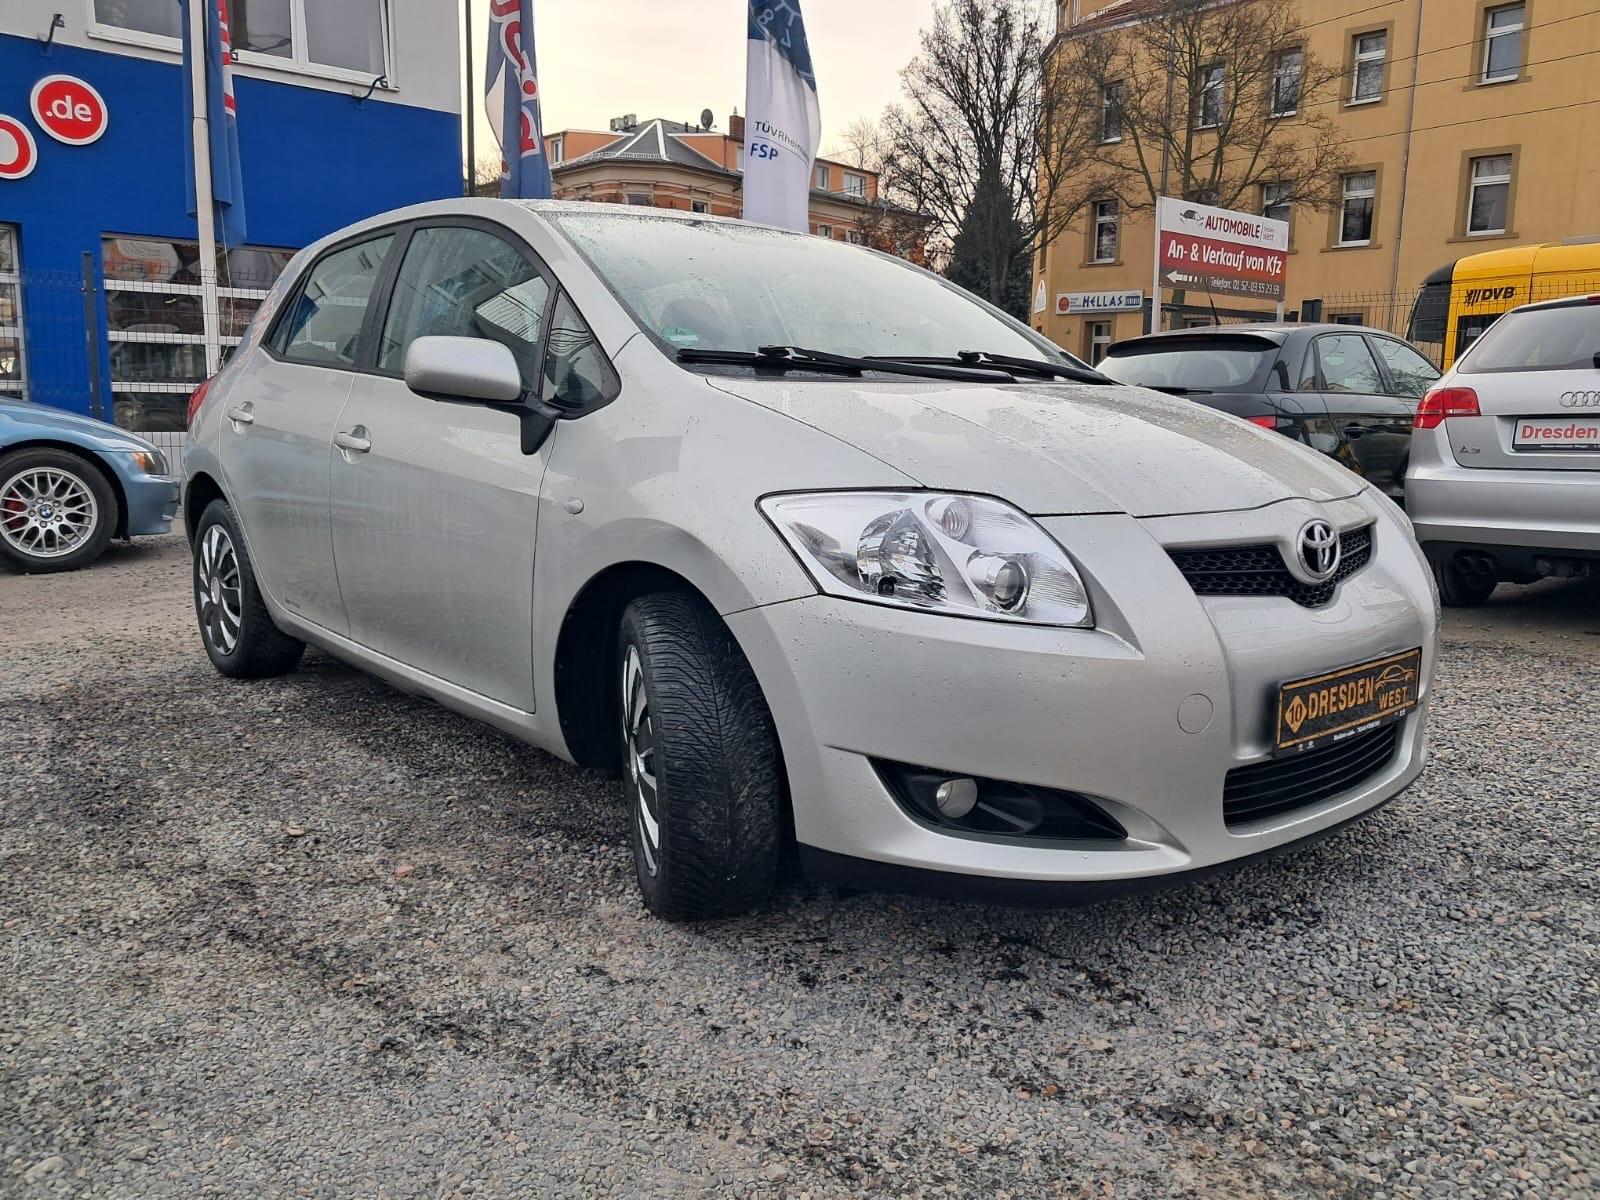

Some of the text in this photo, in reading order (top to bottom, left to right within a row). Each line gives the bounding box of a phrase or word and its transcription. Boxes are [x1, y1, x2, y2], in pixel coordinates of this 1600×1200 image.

[46, 95, 92, 122] .de
[750, 143, 779, 160] FSP
[1205, 215, 1261, 239] AUTOMOBILE
[1167, 239, 1282, 276] An- & Verkauf von Kfz
[1082, 295, 1123, 308] HELLAS
[1481, 286, 1515, 300] DVB
[1521, 424, 1599, 439] Dresden
[1308, 677, 1374, 719] DRESDEN
[1379, 687, 1408, 709] WEST
